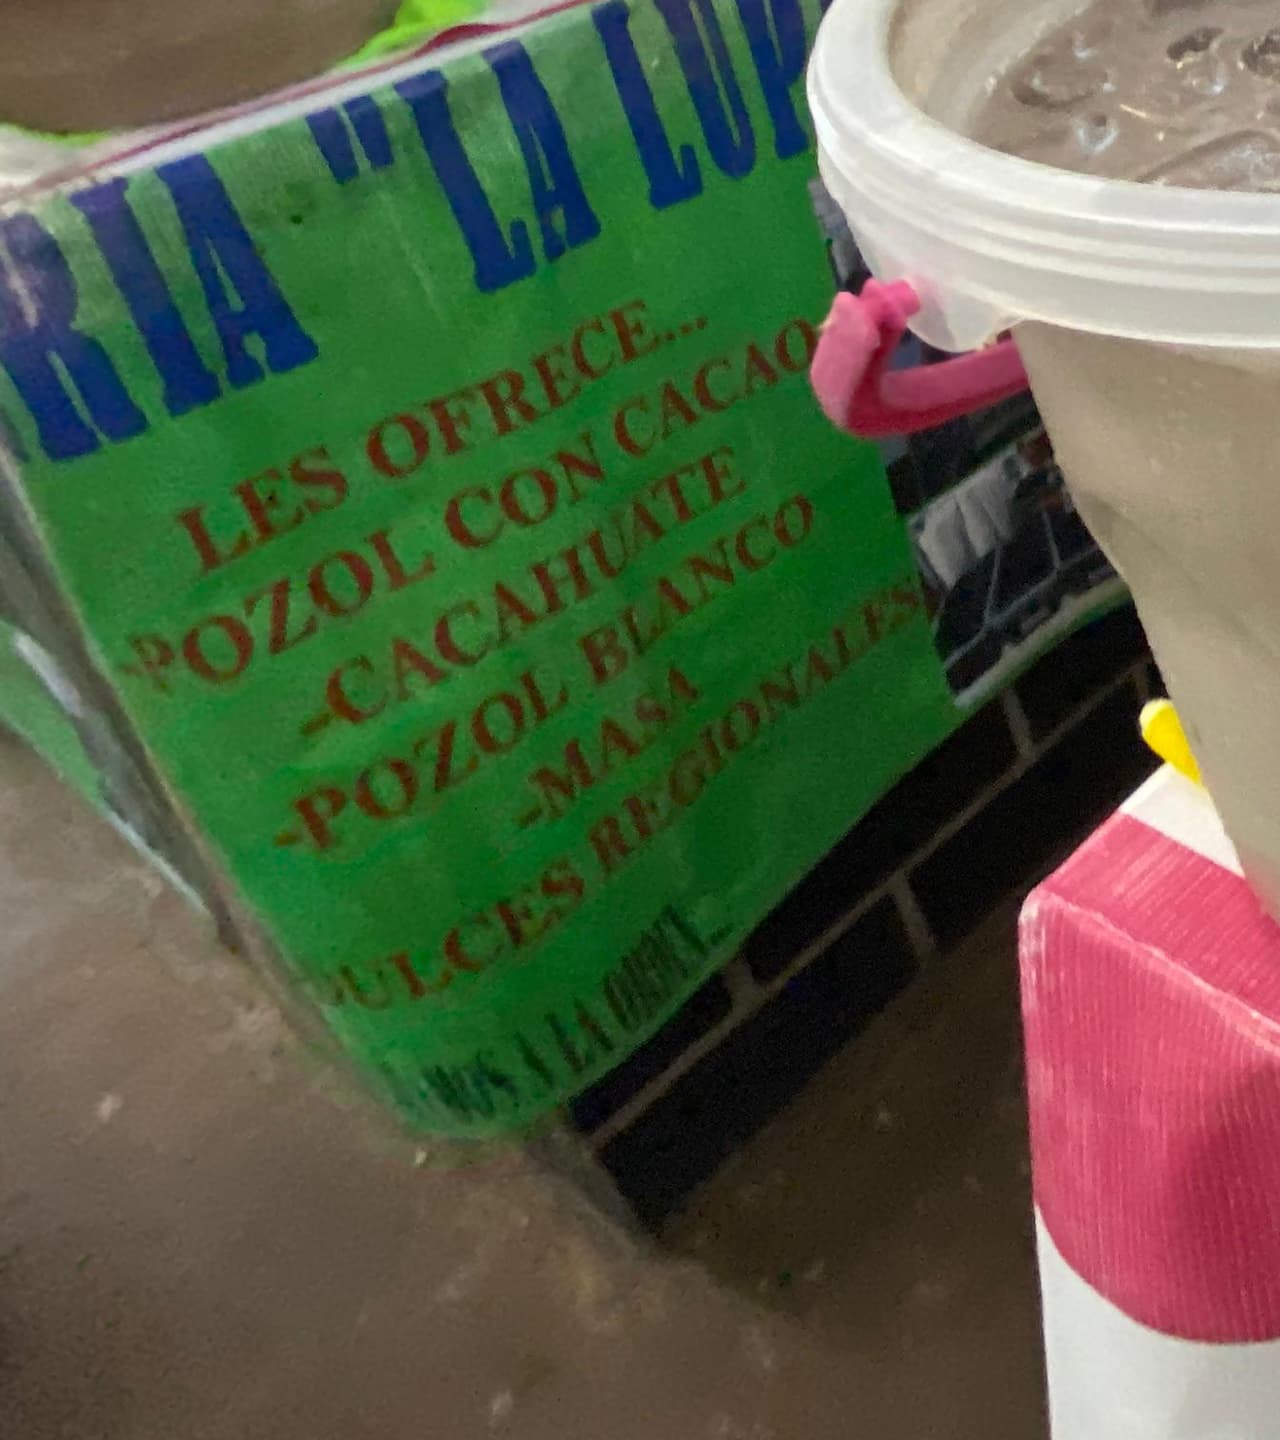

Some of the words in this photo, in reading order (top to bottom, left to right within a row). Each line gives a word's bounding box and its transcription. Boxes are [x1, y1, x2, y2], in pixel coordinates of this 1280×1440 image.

[0, 154, 319, 463] RIA
[173, 445, 349, 574] LES
[365, 298, 709, 481] OFRECE...
[444, 430, 606, 550] CON
[613, 318, 818, 458] CACAO
[577, 491, 815, 684] BLANCO
[322, 856, 586, 1012] ULCES
